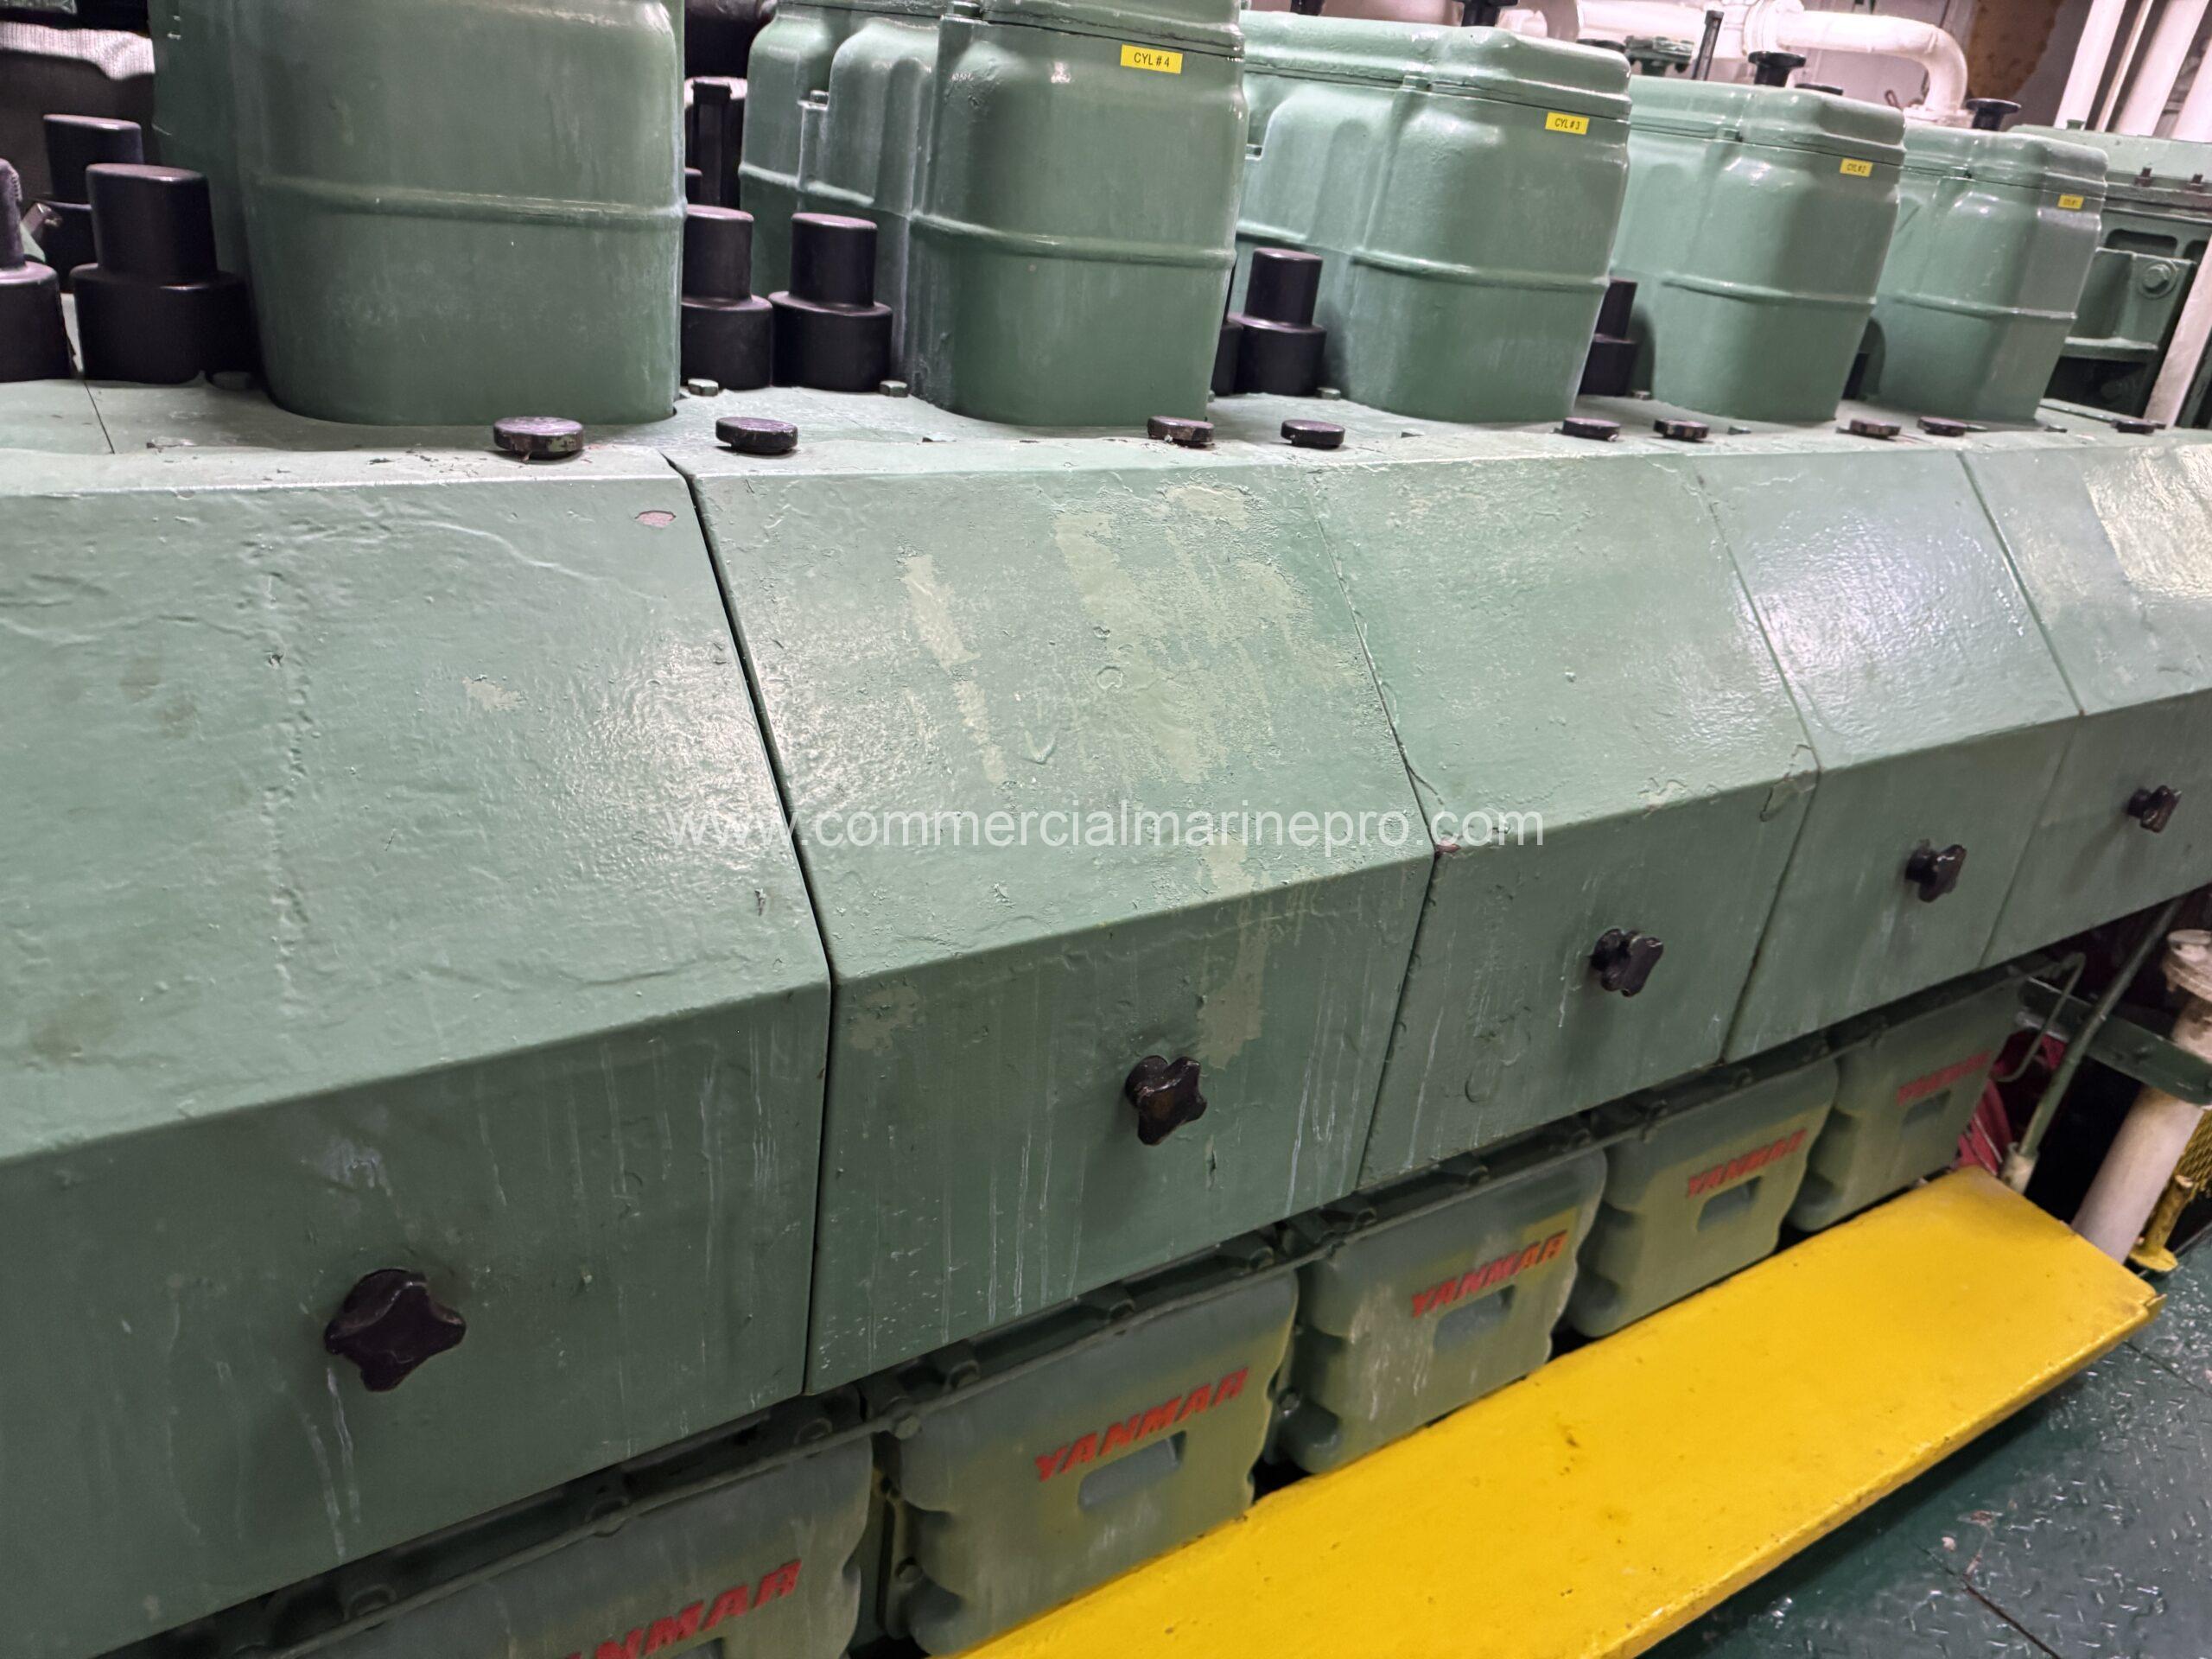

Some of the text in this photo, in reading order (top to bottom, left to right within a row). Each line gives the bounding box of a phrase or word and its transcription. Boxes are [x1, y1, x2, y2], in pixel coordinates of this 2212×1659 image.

[1134, 52, 1154, 66] CYL
[1411, 1229, 1567, 1319] YANMAR
[1035, 1367, 1249, 1483] YANMAR
